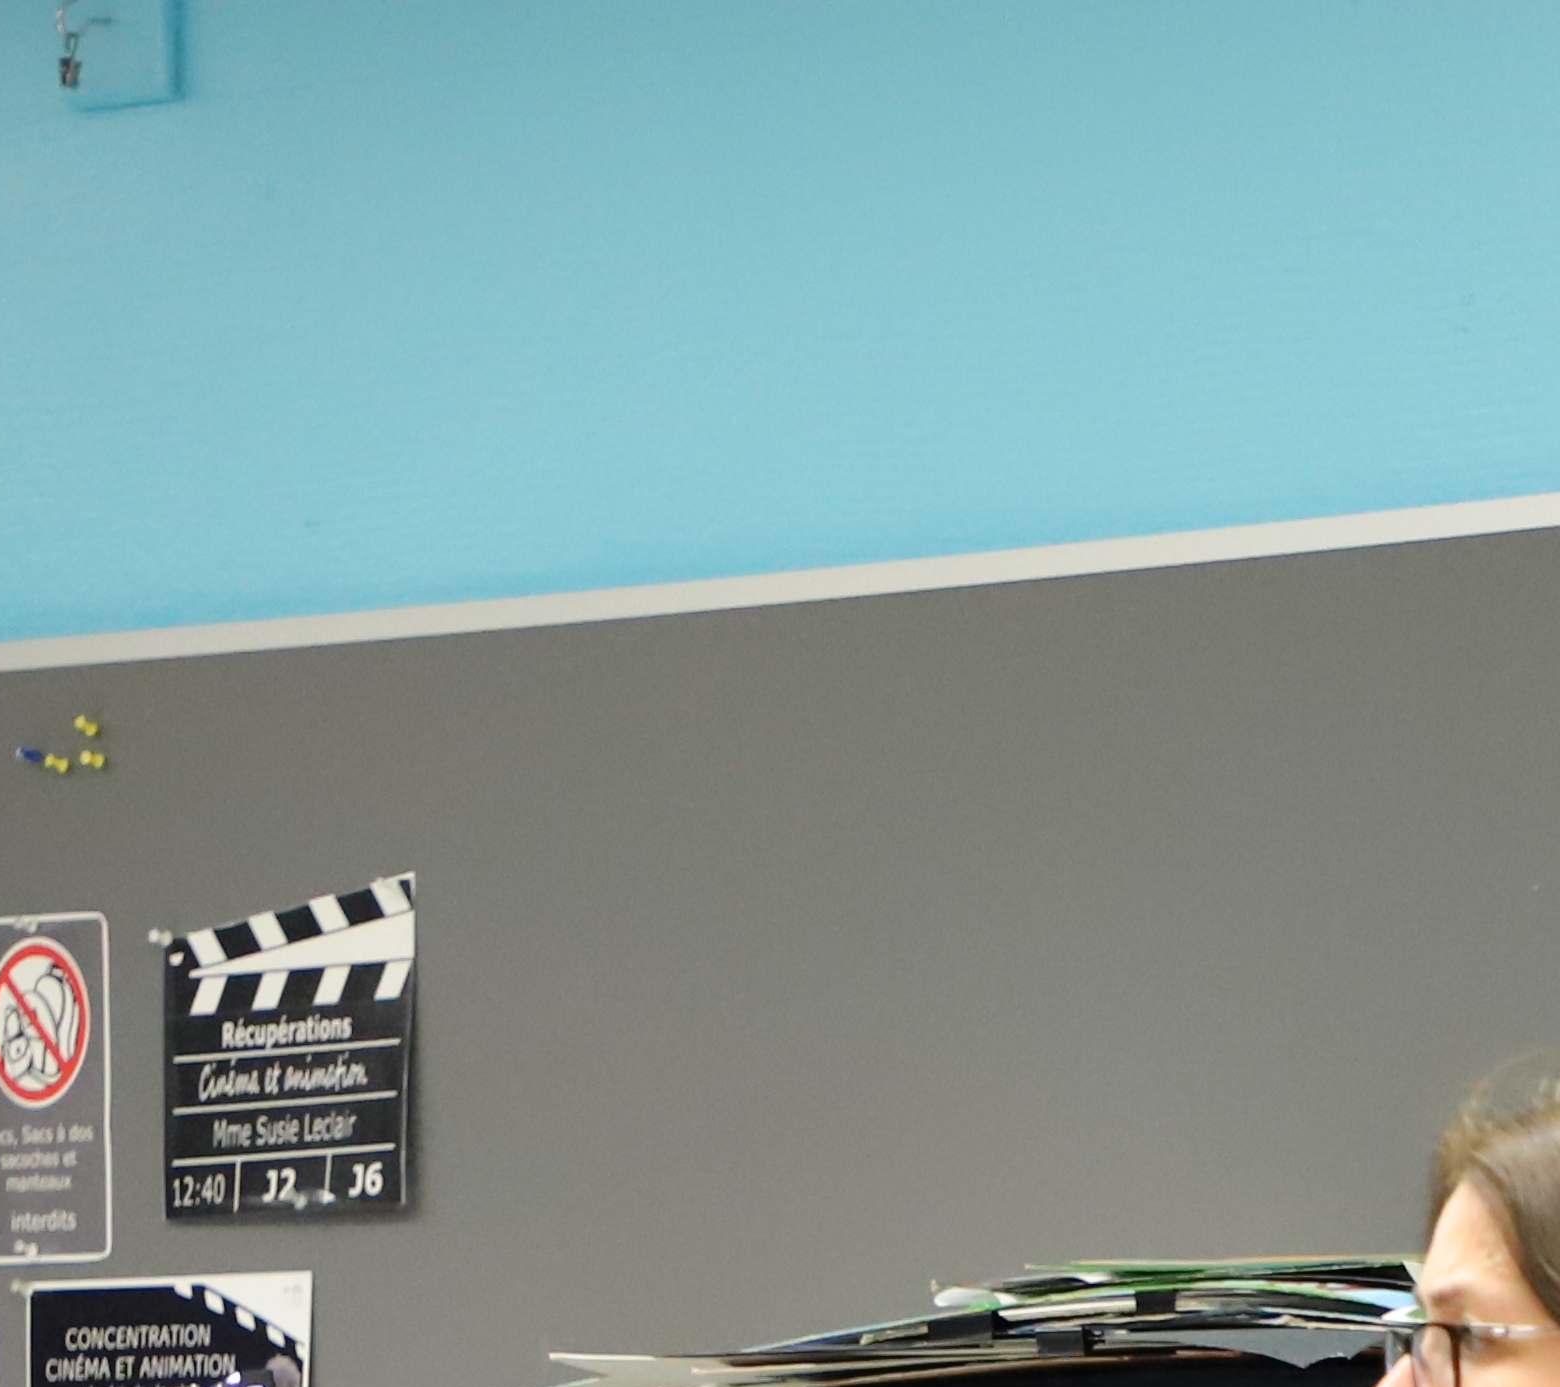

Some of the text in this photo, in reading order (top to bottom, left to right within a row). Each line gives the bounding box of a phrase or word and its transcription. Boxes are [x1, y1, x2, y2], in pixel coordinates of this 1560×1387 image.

[221, 1014, 353, 1050] Récupérations
[264, 1060, 282, 1095] et
[212, 1119, 251, 1149] Mme
[256, 1113, 300, 1147] Susie
[173, 1160, 384, 1208] 12:40 J2 J6
[65, 1323, 212, 1352] CONCENTRATION
[45, 1352, 237, 1383] CINÉMA ET ANIMATION
